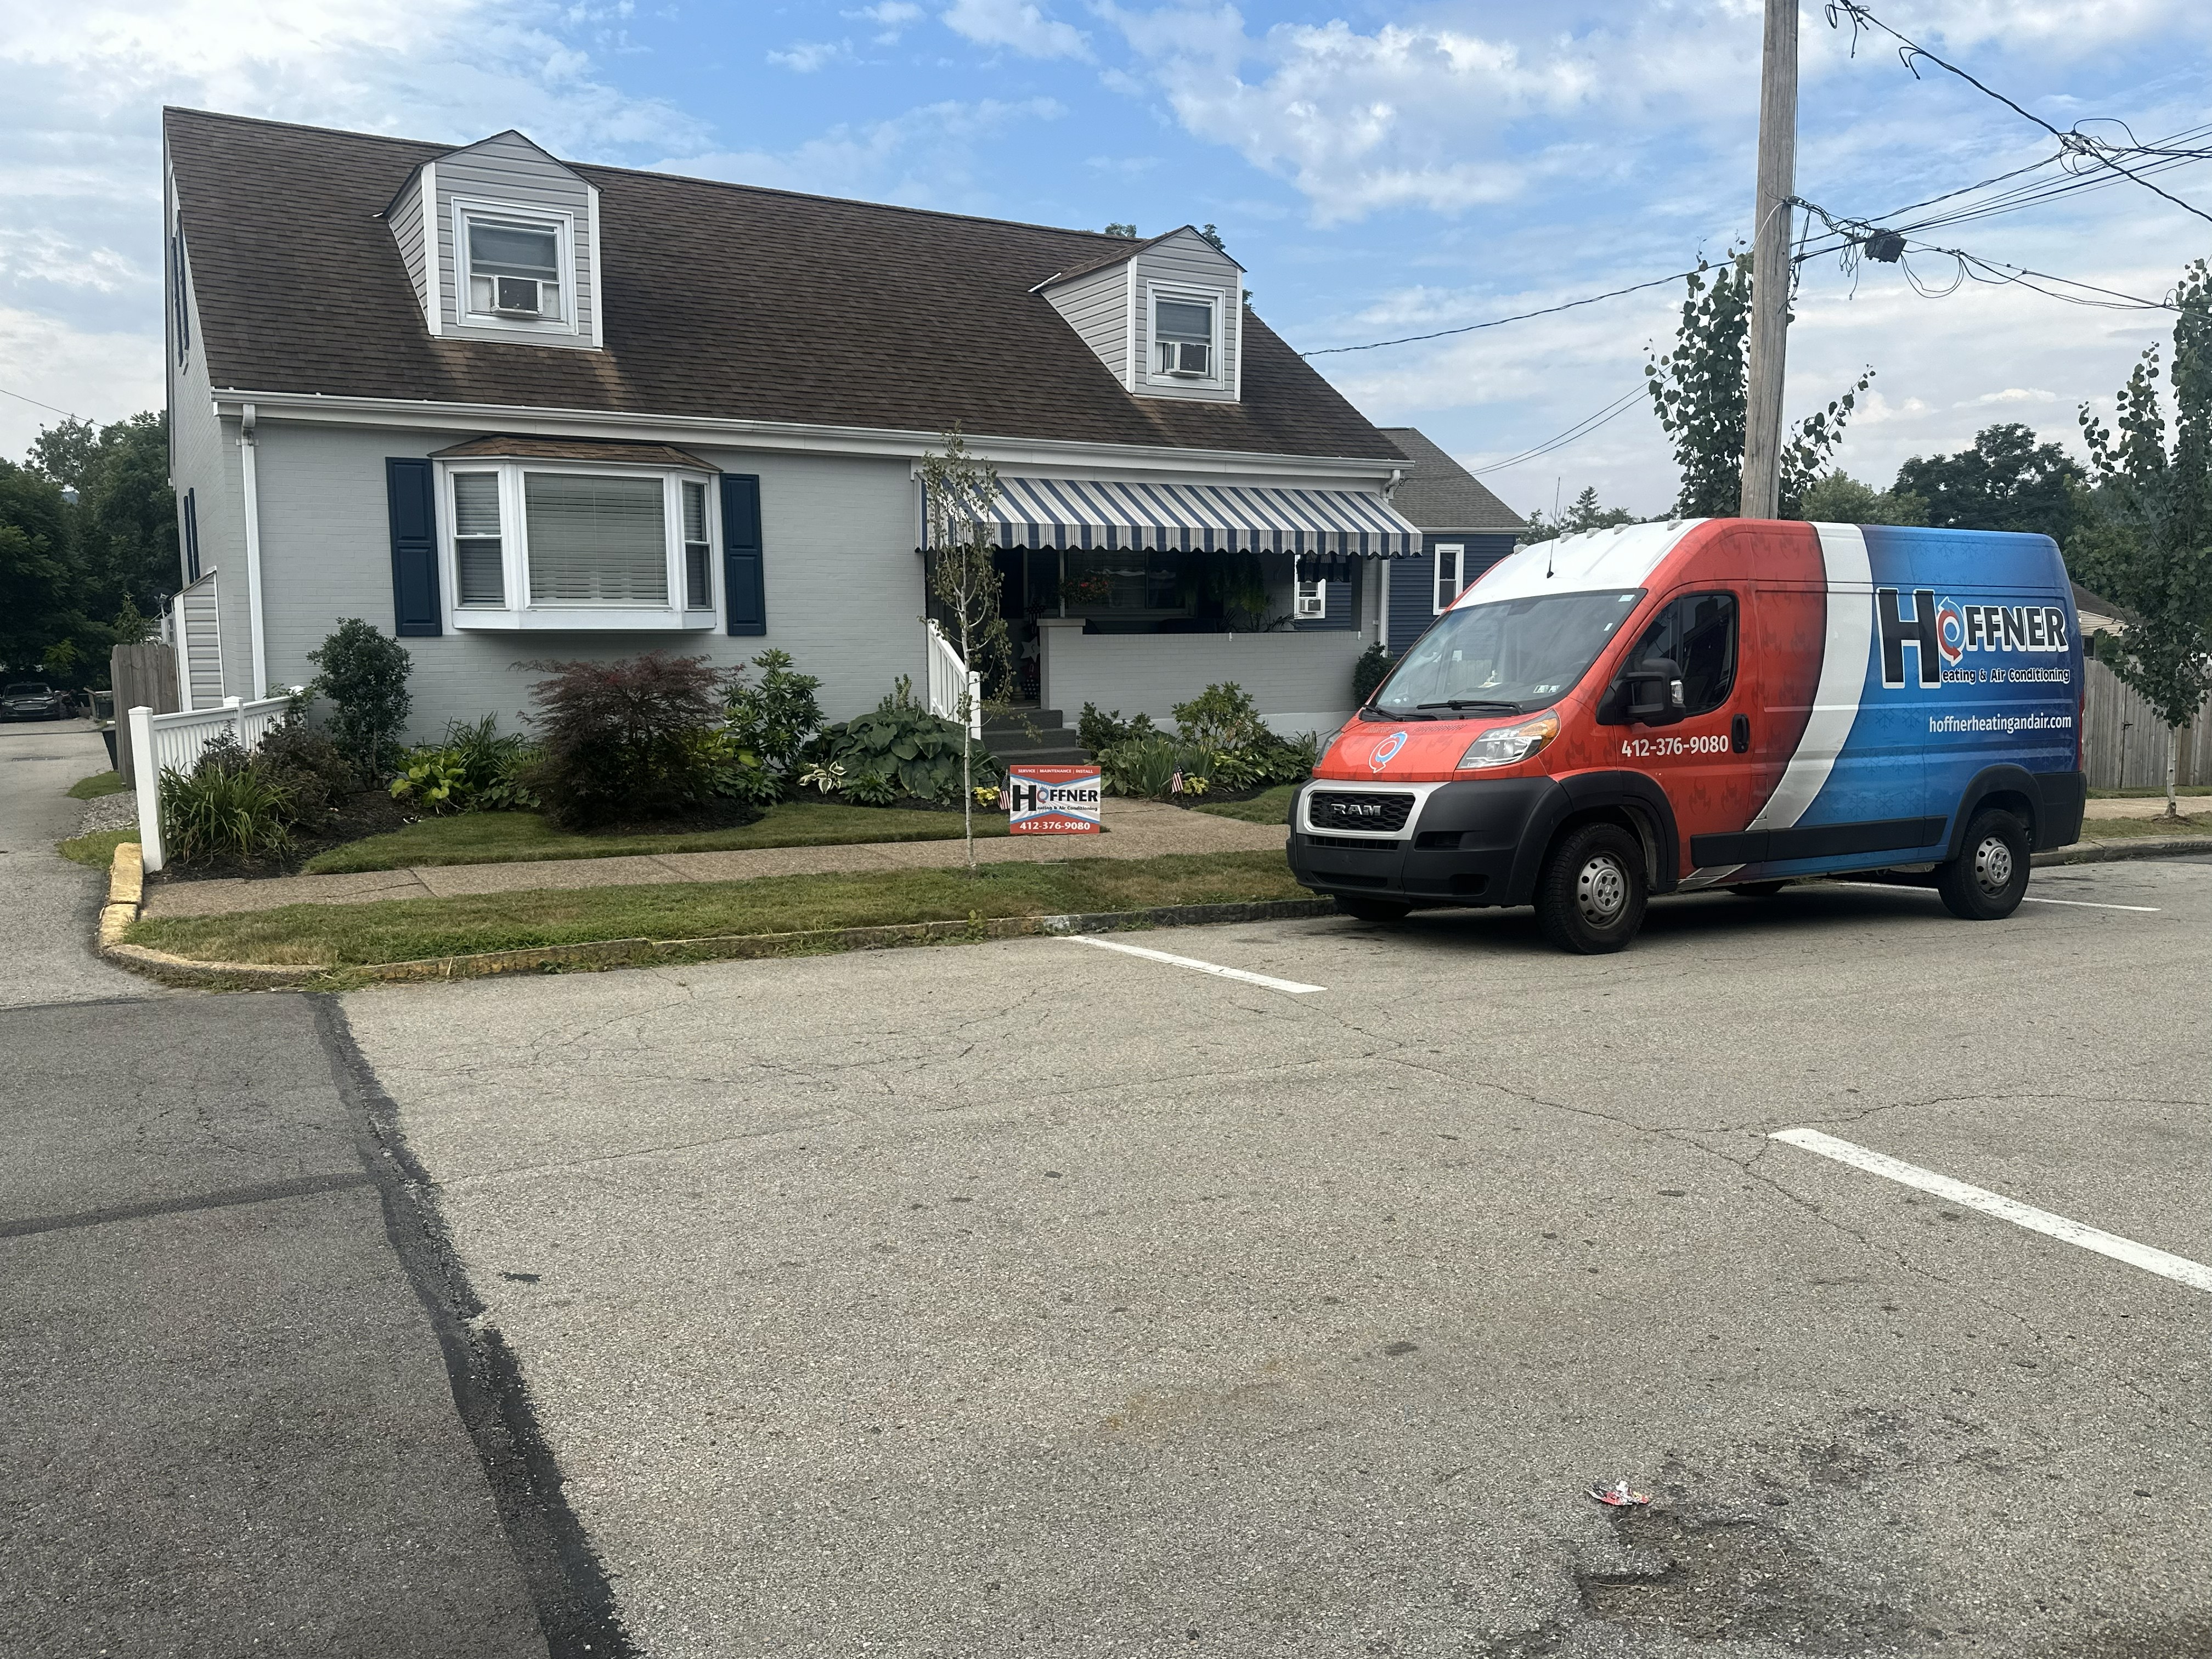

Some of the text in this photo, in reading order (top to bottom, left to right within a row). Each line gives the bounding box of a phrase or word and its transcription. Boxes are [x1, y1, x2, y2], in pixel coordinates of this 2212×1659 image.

[1877, 588, 2069, 688] HOFFNER
[1979, 668, 1987, 682] &
[1990, 668, 2006, 682] Air
[2008, 667, 2070, 684] Conditioning
[1929, 712, 2072, 733] hoffnerheatingandair.com
[1621, 735, 1728, 757] 412-376-9080
[1012, 785, 1098, 811] HOFFNER
[1330, 804, 1381, 816] RAM
[1019, 822, 1091, 830] 412-376-9080
